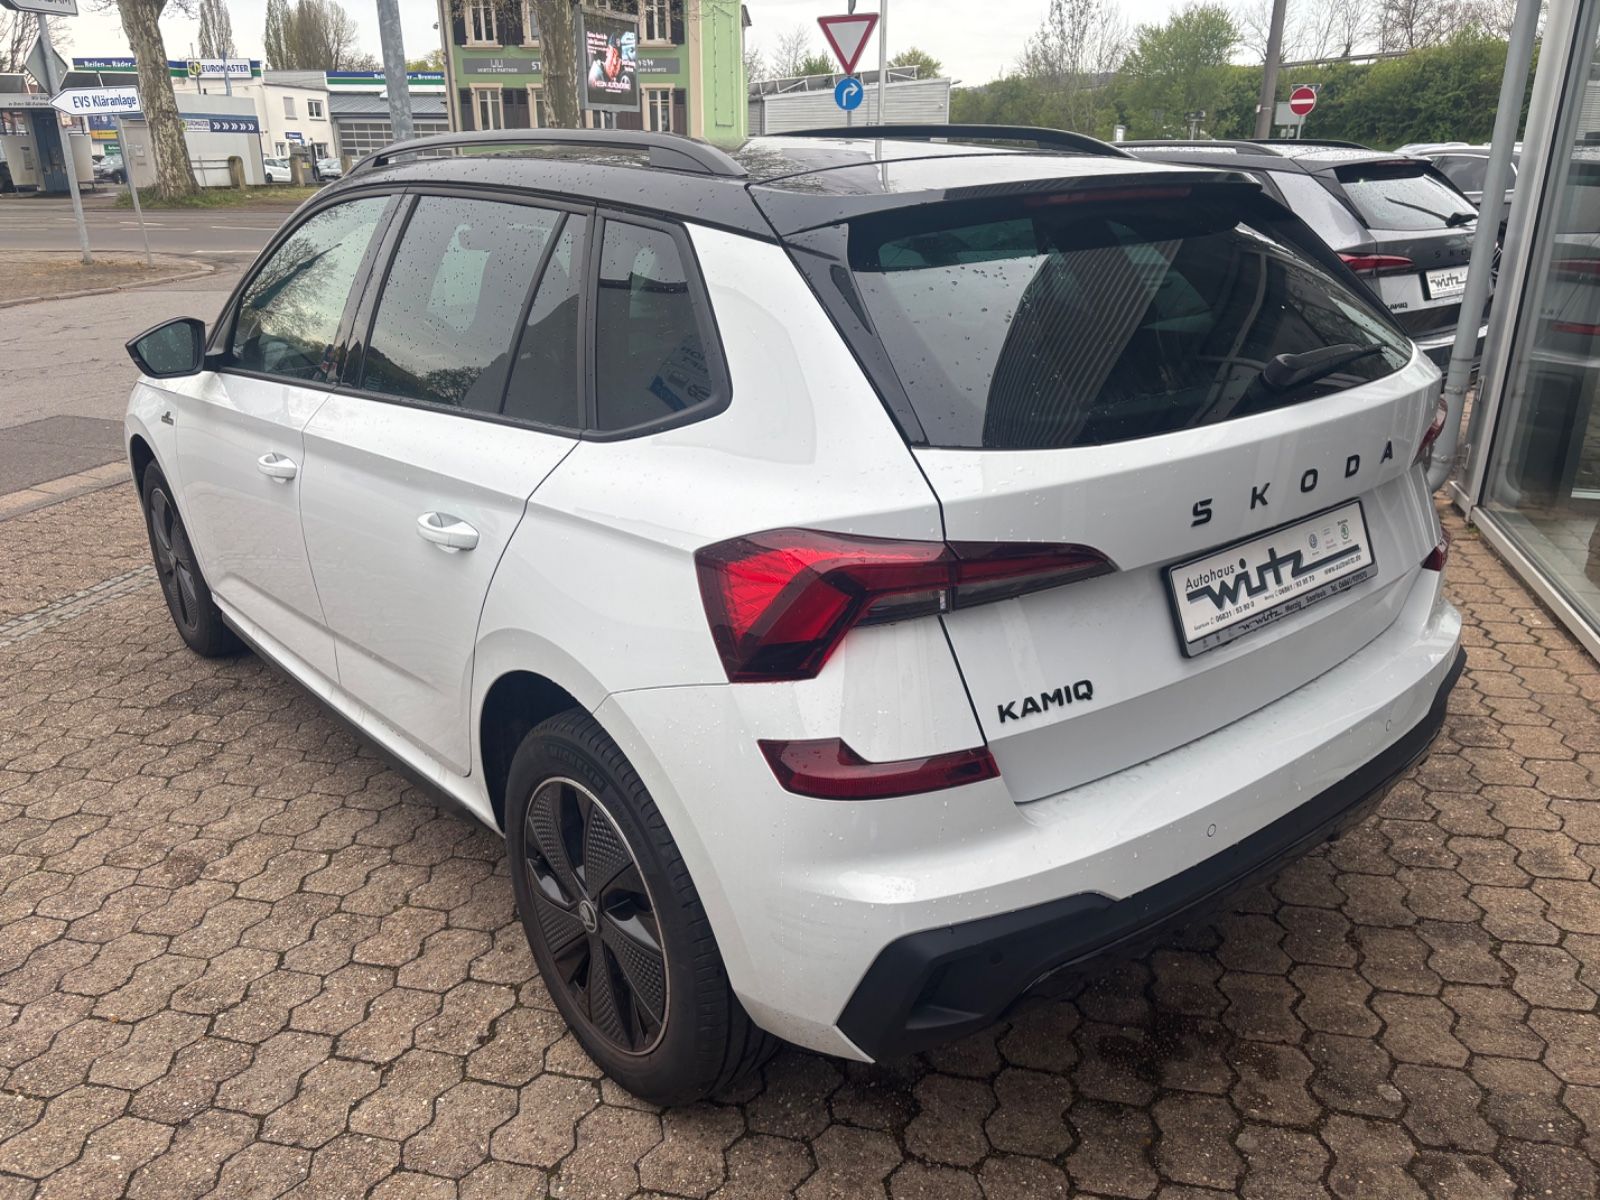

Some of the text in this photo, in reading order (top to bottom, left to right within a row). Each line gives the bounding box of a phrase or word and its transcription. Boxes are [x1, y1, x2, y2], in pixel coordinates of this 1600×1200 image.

[73, 94, 137, 108] EVS Kläranlage
[1386, 301, 1408, 310] AMIQ
[1190, 440, 1394, 528] SKODA
[1186, 564, 1235, 591] Autohaus
[997, 679, 1094, 723] KAMIQ
